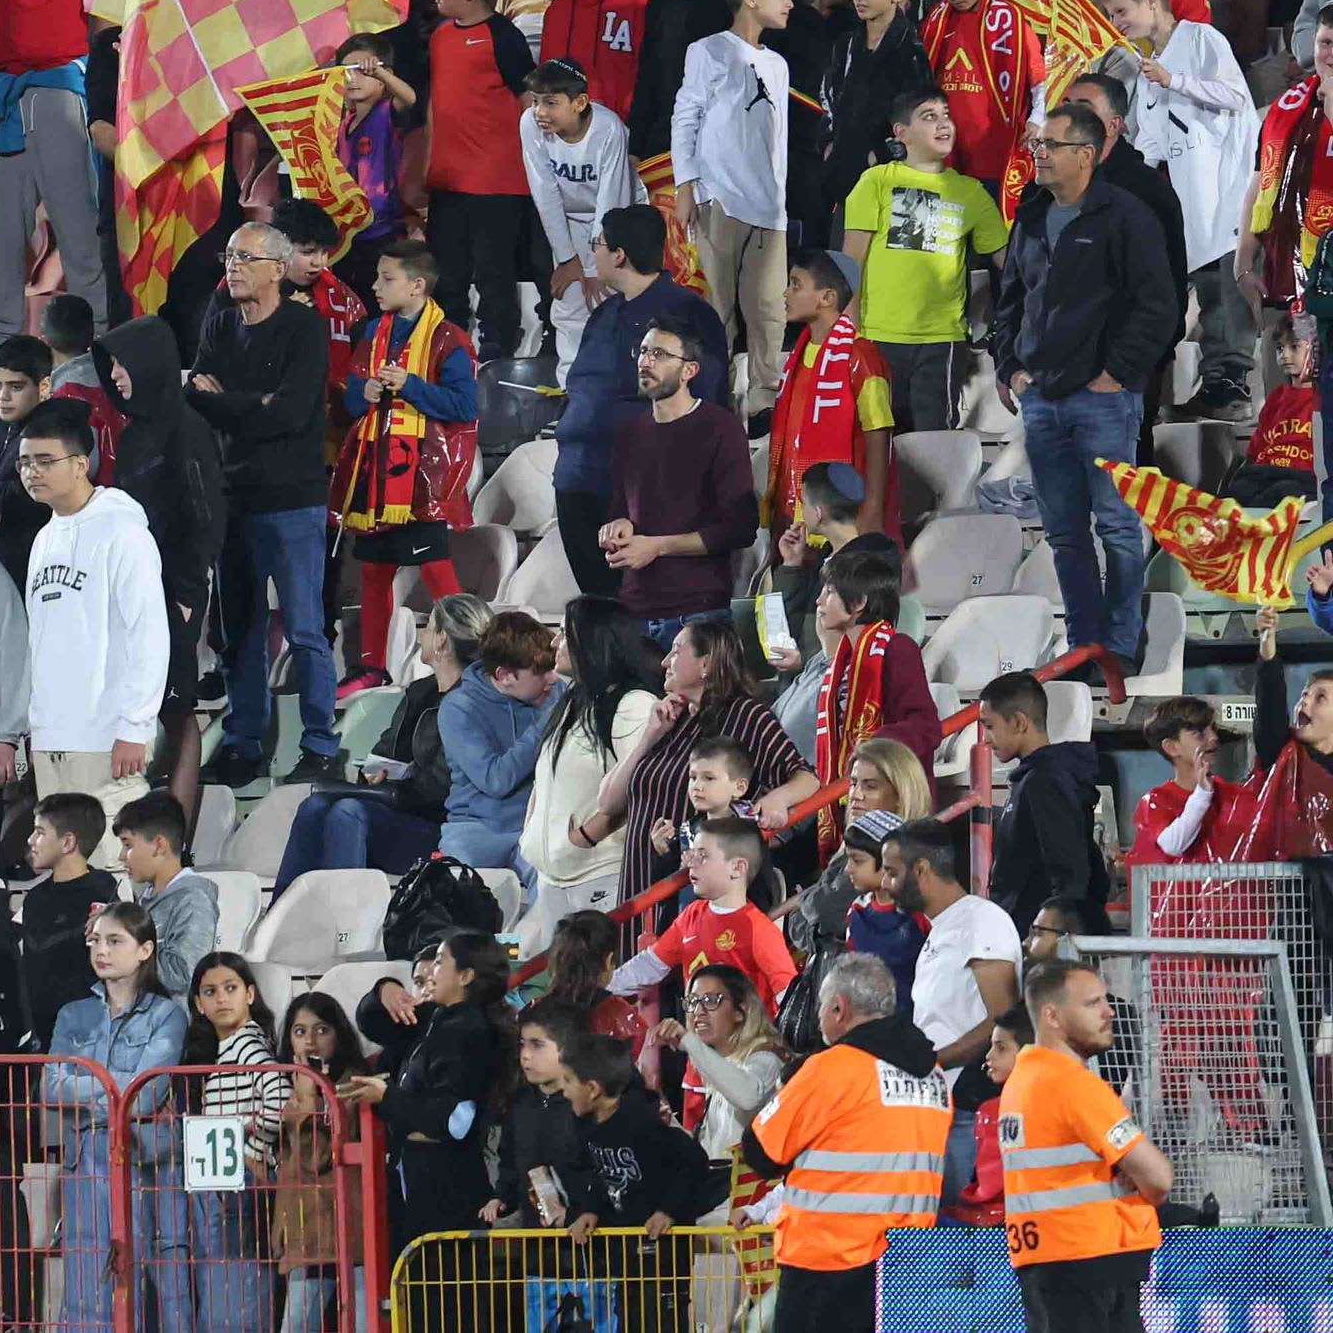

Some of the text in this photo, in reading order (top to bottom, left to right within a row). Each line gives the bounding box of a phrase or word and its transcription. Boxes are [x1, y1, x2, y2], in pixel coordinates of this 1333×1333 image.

[1263, 418, 1313, 445] ULTRA
[972, 575, 983, 585] 27
[1001, 661, 1013, 672] 29
[1226, 705, 1233, 719] 8
[16, 762, 27, 772] 22
[338, 932, 349, 943] 27
[1008, 1220, 1040, 1254] 36
